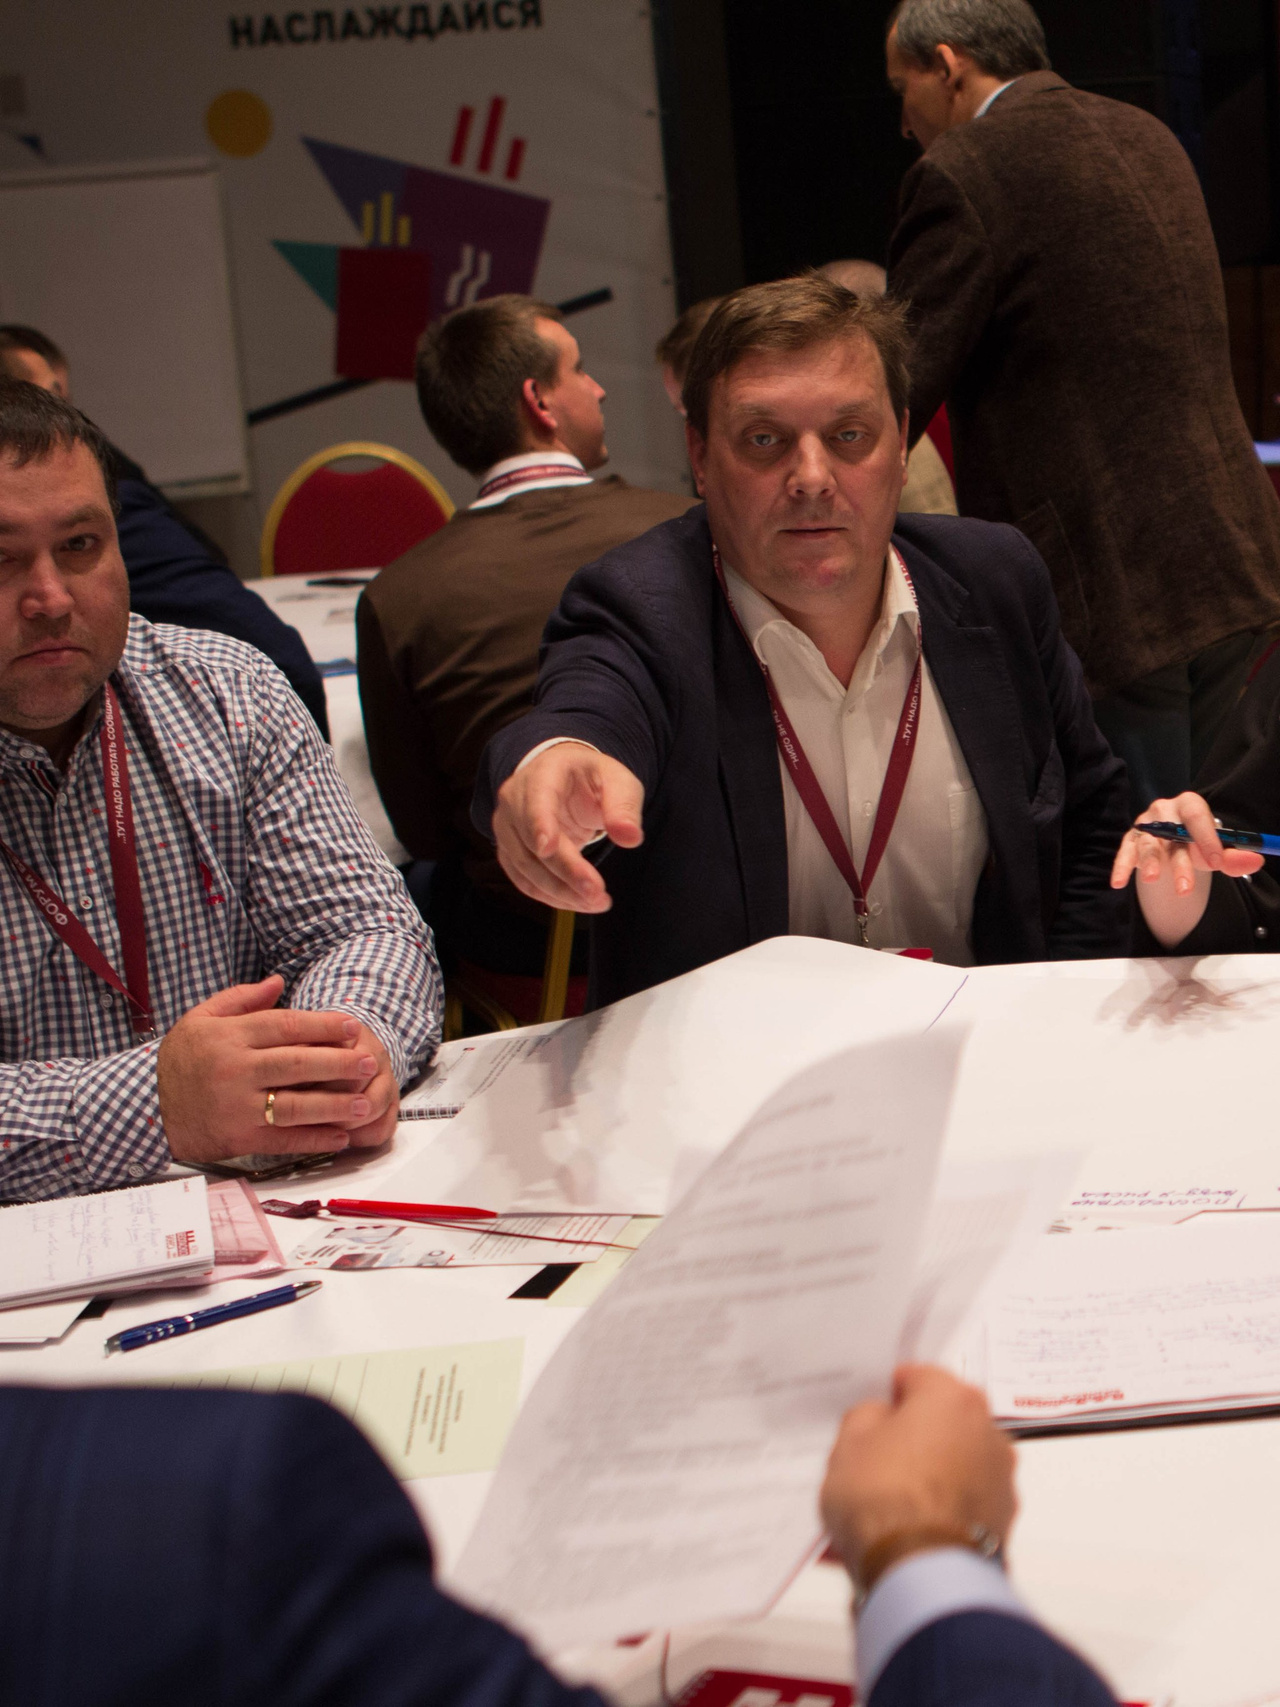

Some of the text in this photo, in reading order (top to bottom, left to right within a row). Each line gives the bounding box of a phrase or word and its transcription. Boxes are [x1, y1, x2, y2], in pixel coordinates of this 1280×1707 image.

[906, 694, 921, 722] НАДО
[776, 723, 787, 737] НЕ
[109, 742, 122, 788] РАБОТАТЬ
[114, 790, 125, 818] НАДО
[24, 874, 70, 927] ФОРУМ
